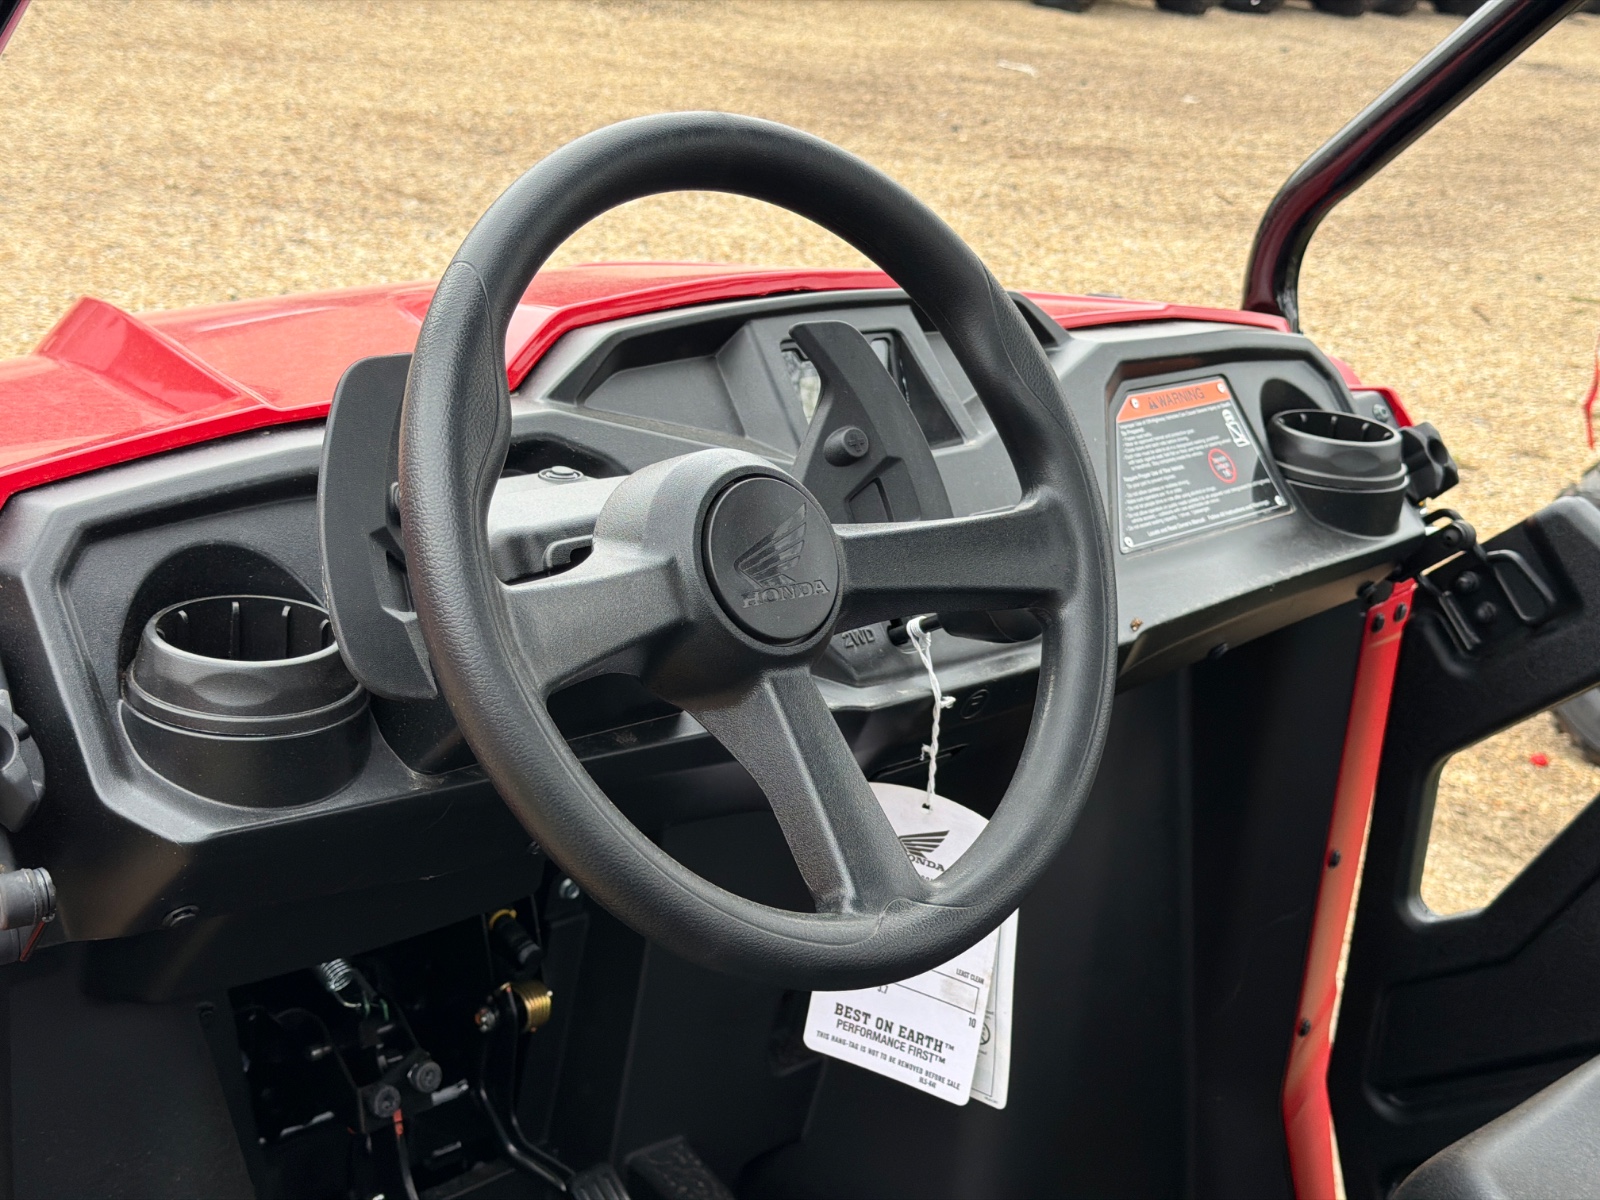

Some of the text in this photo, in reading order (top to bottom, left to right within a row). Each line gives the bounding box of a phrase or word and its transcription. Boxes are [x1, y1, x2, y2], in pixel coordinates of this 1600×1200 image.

[1156, 388, 1205, 408] WARNING
[742, 579, 830, 609] HONDA
[841, 627, 876, 649] 2WD
[907, 854, 945, 872] ONDA
[834, 1002, 872, 1025] BEST
[875, 1017, 894, 1034] ON
[968, 1016, 977, 1029] 10
[836, 1018, 907, 1053] PERFORMANCE
[816, 1030, 830, 1041] THIS
[831, 1035, 859, 1050] HANG-TAG
[860, 1044, 867, 1053] IS
[867, 1047, 880, 1058] NOT
[880, 1052, 888, 1061] TO
[888, 1055, 897, 1064] BE
[897, 1059, 924, 1075] REMOVED
[924, 1070, 946, 1084] BEFORE
[946, 1078, 961, 1091] SALE
